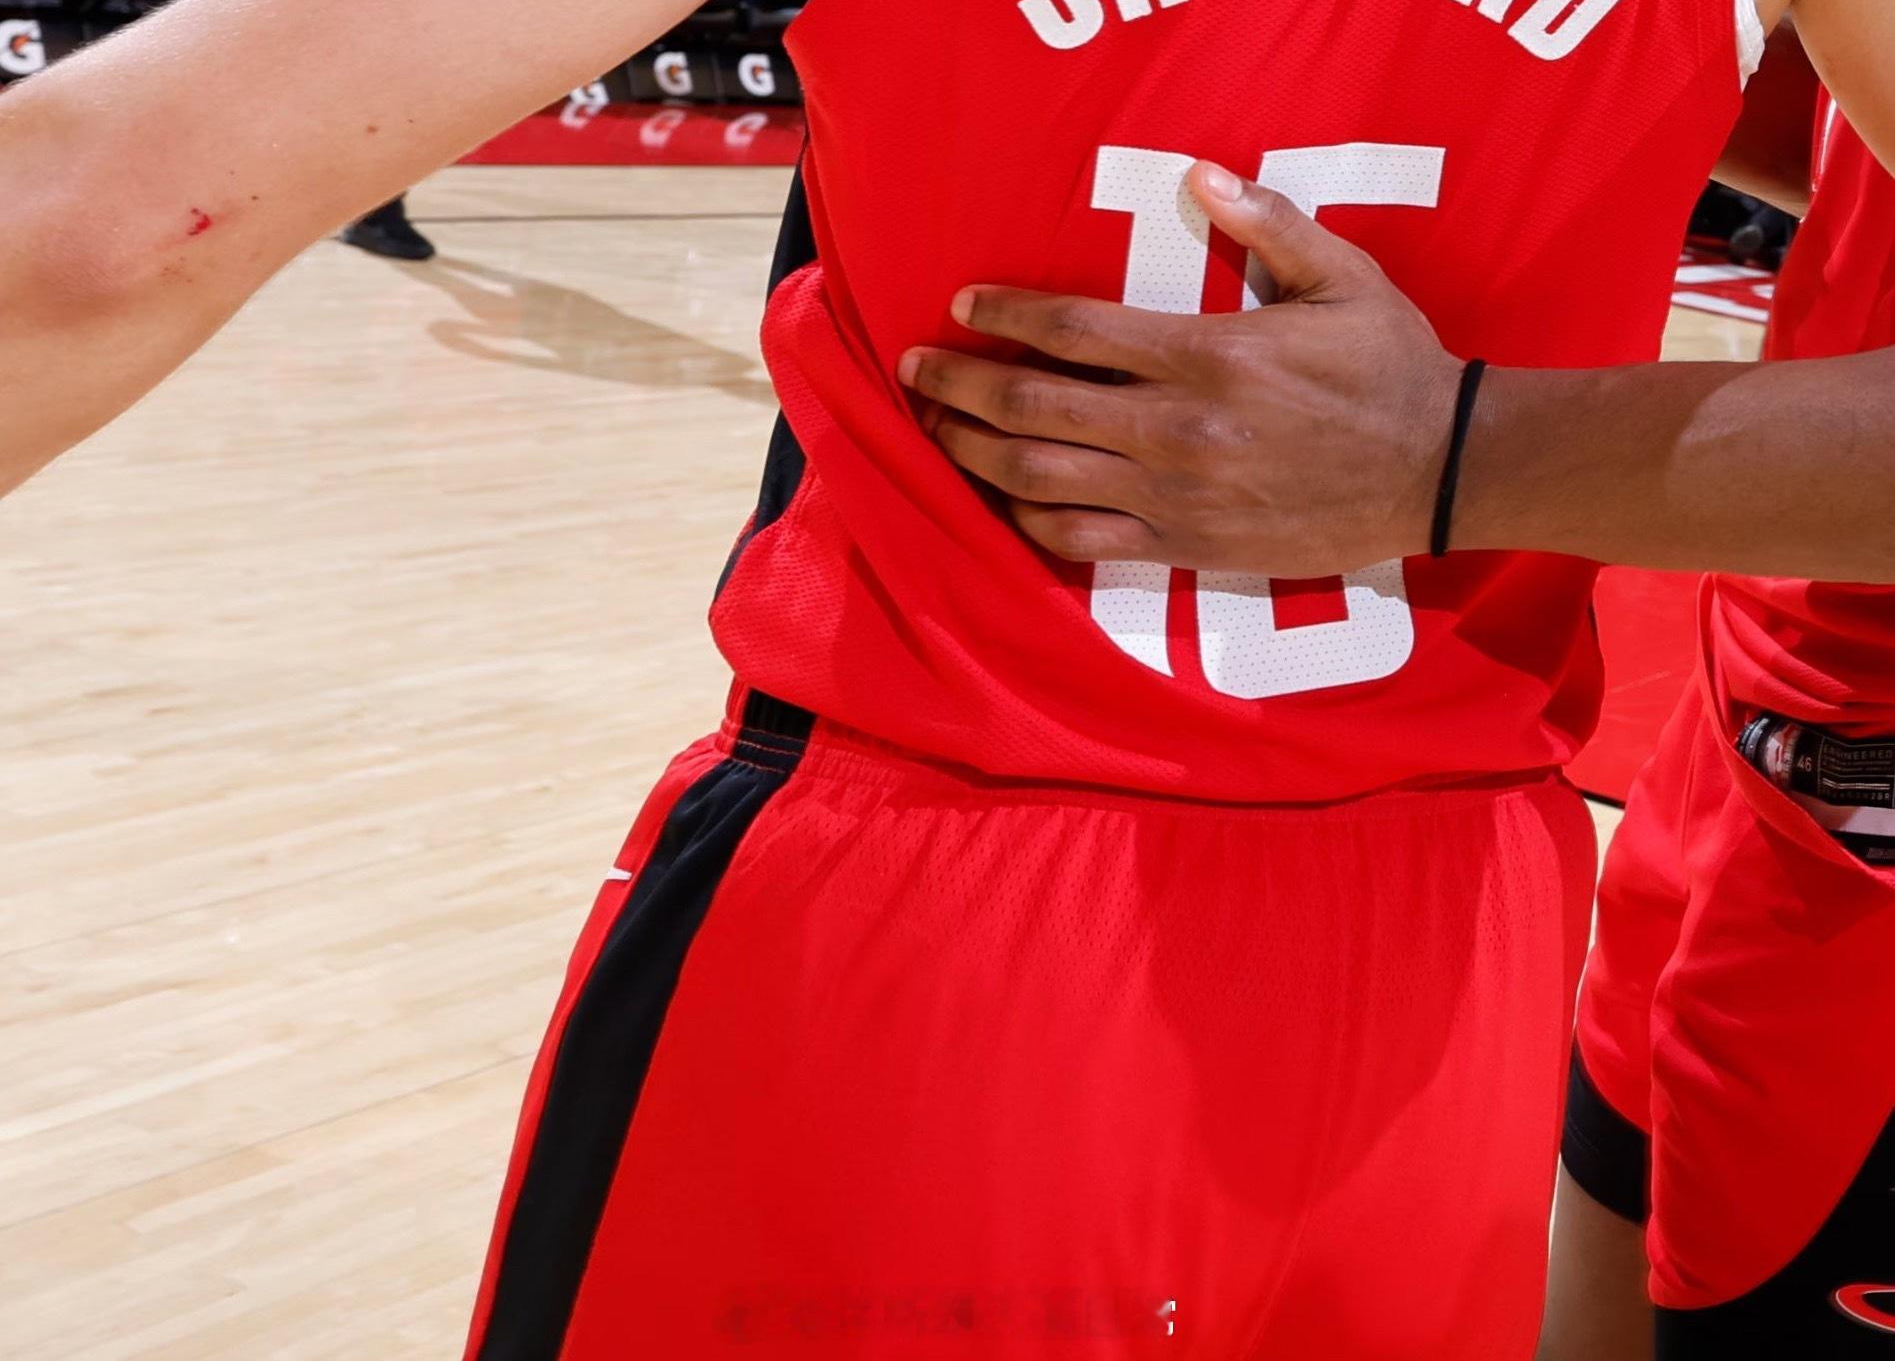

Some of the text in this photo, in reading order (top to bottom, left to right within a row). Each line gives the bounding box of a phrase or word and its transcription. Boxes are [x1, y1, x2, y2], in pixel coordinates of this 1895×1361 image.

[0, 19, 47, 75] G
[653, 51, 693, 97] G
[738, 53, 776, 97] G
[1797, 755, 1812, 772] 46
